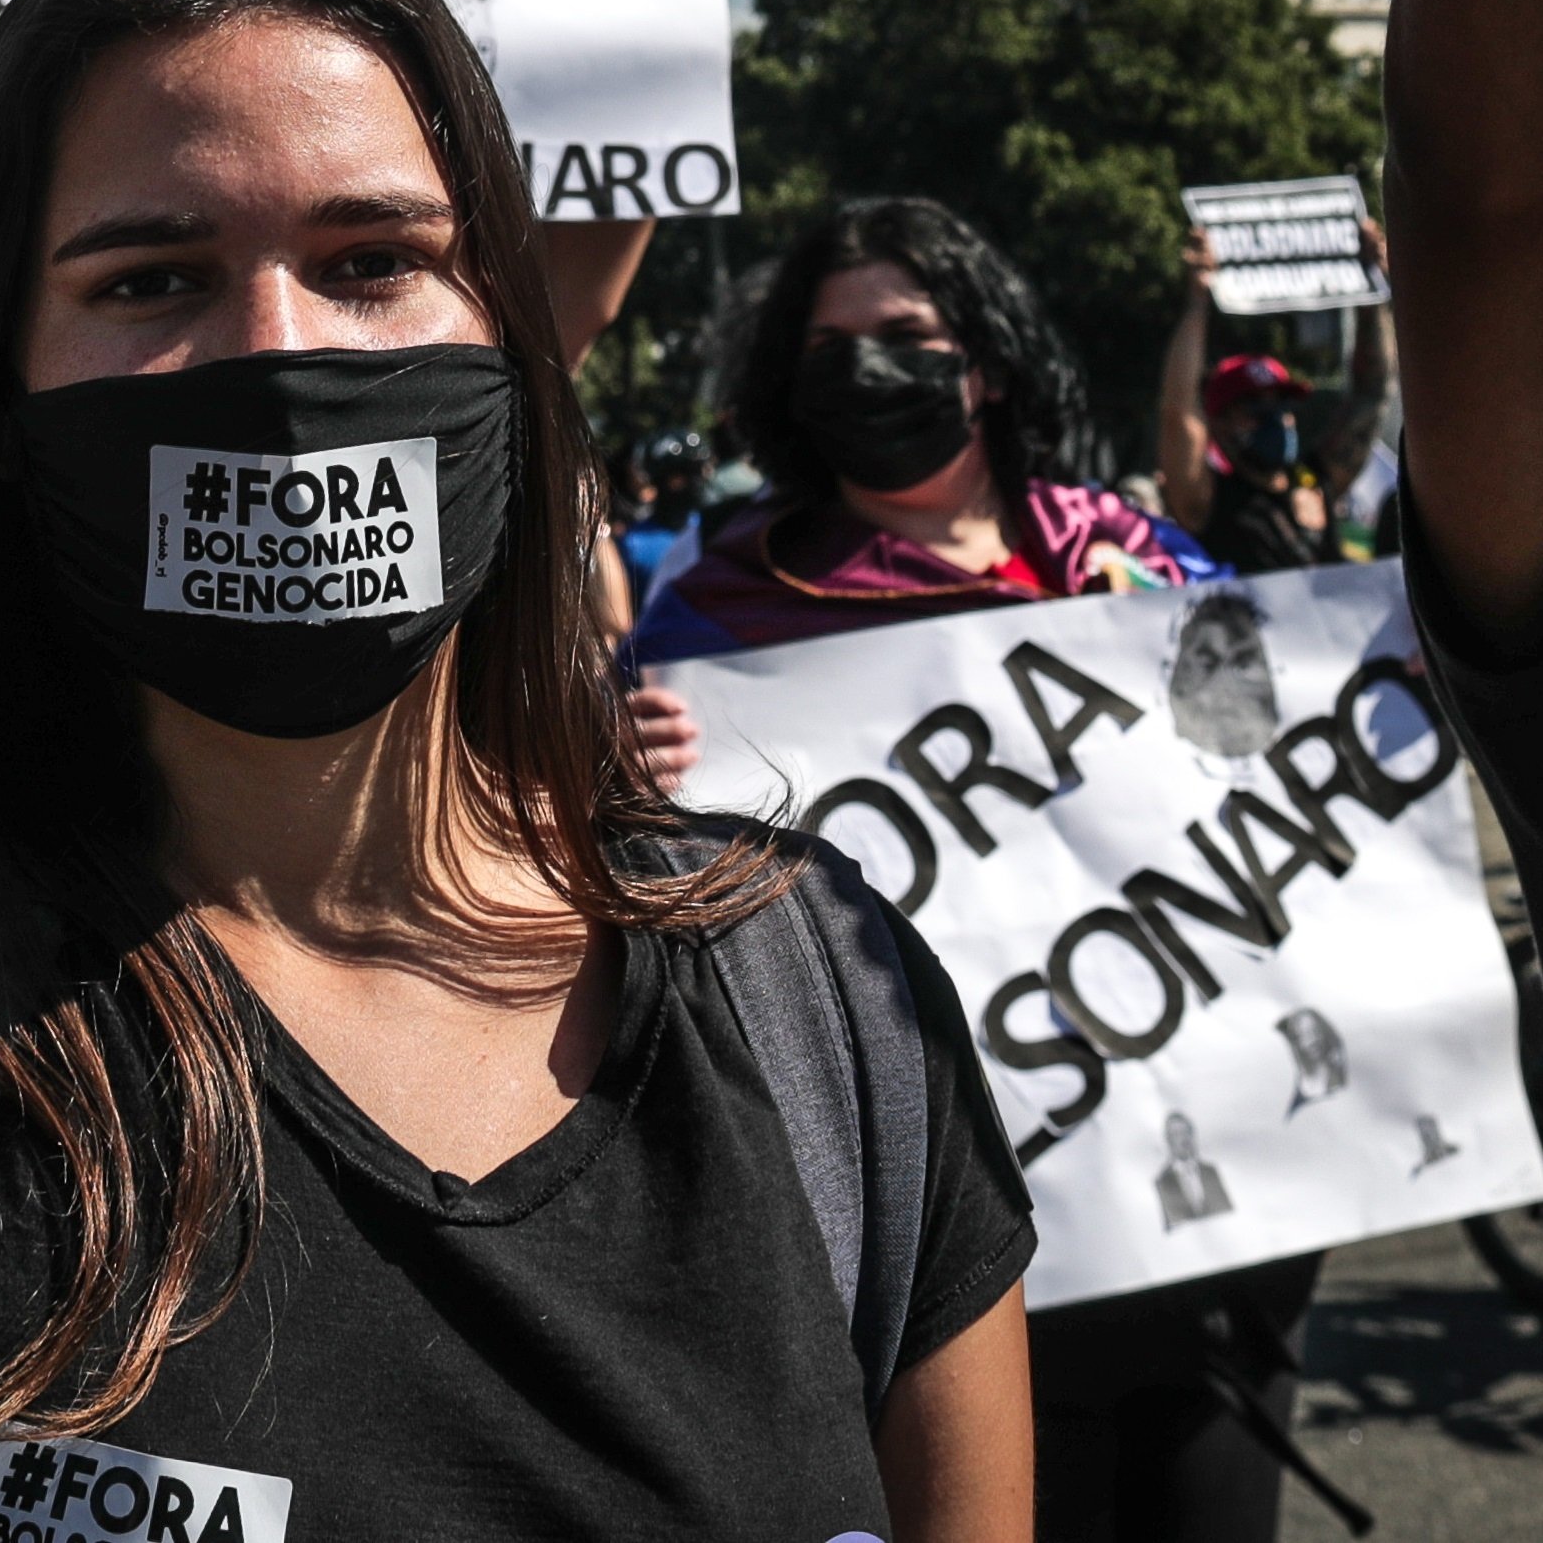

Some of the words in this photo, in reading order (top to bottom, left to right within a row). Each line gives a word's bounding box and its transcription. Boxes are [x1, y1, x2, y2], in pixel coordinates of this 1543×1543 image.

[183, 457, 409, 528] #FORA
[183, 520, 414, 568] BOLSONARO
[182, 562, 409, 614] GENOCIDA
[798, 640, 1147, 920] ORA
[979, 656, 1459, 1171] SONARO
[0, 1442, 245, 1543] #FORA
